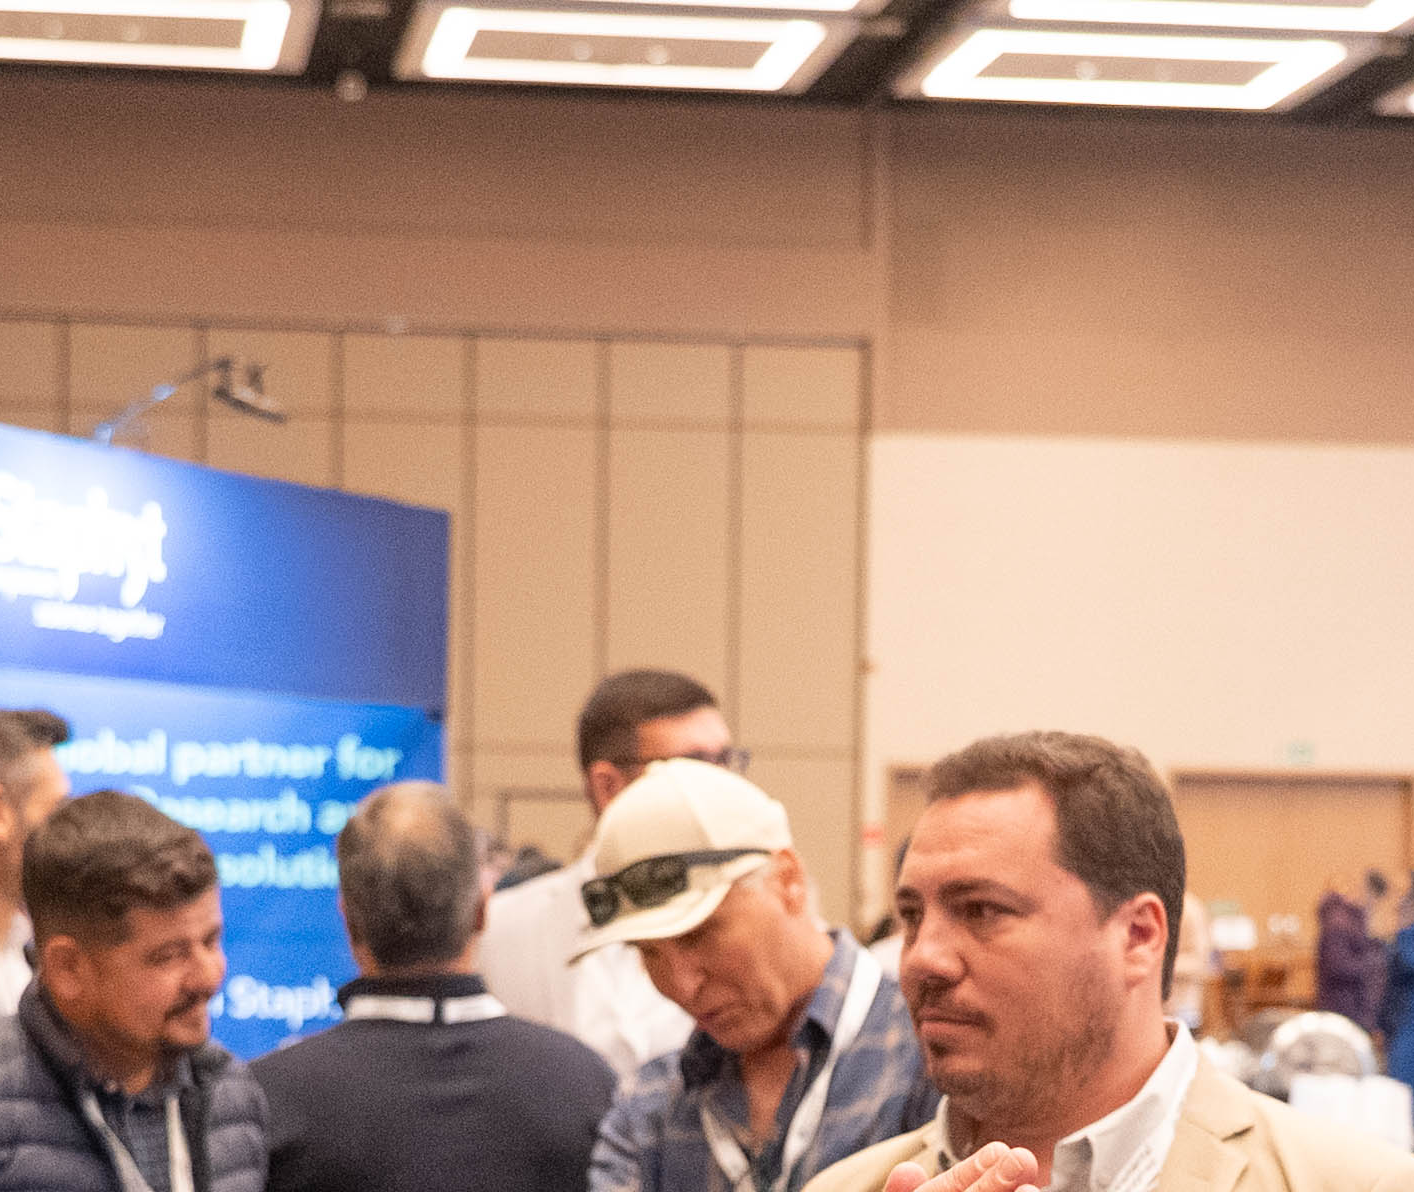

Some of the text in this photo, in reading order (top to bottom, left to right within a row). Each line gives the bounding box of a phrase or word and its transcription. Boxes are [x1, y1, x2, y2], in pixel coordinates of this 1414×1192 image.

[170, 737, 332, 786] partner
[337, 732, 403, 781] for
[130, 784, 313, 834] esearch
